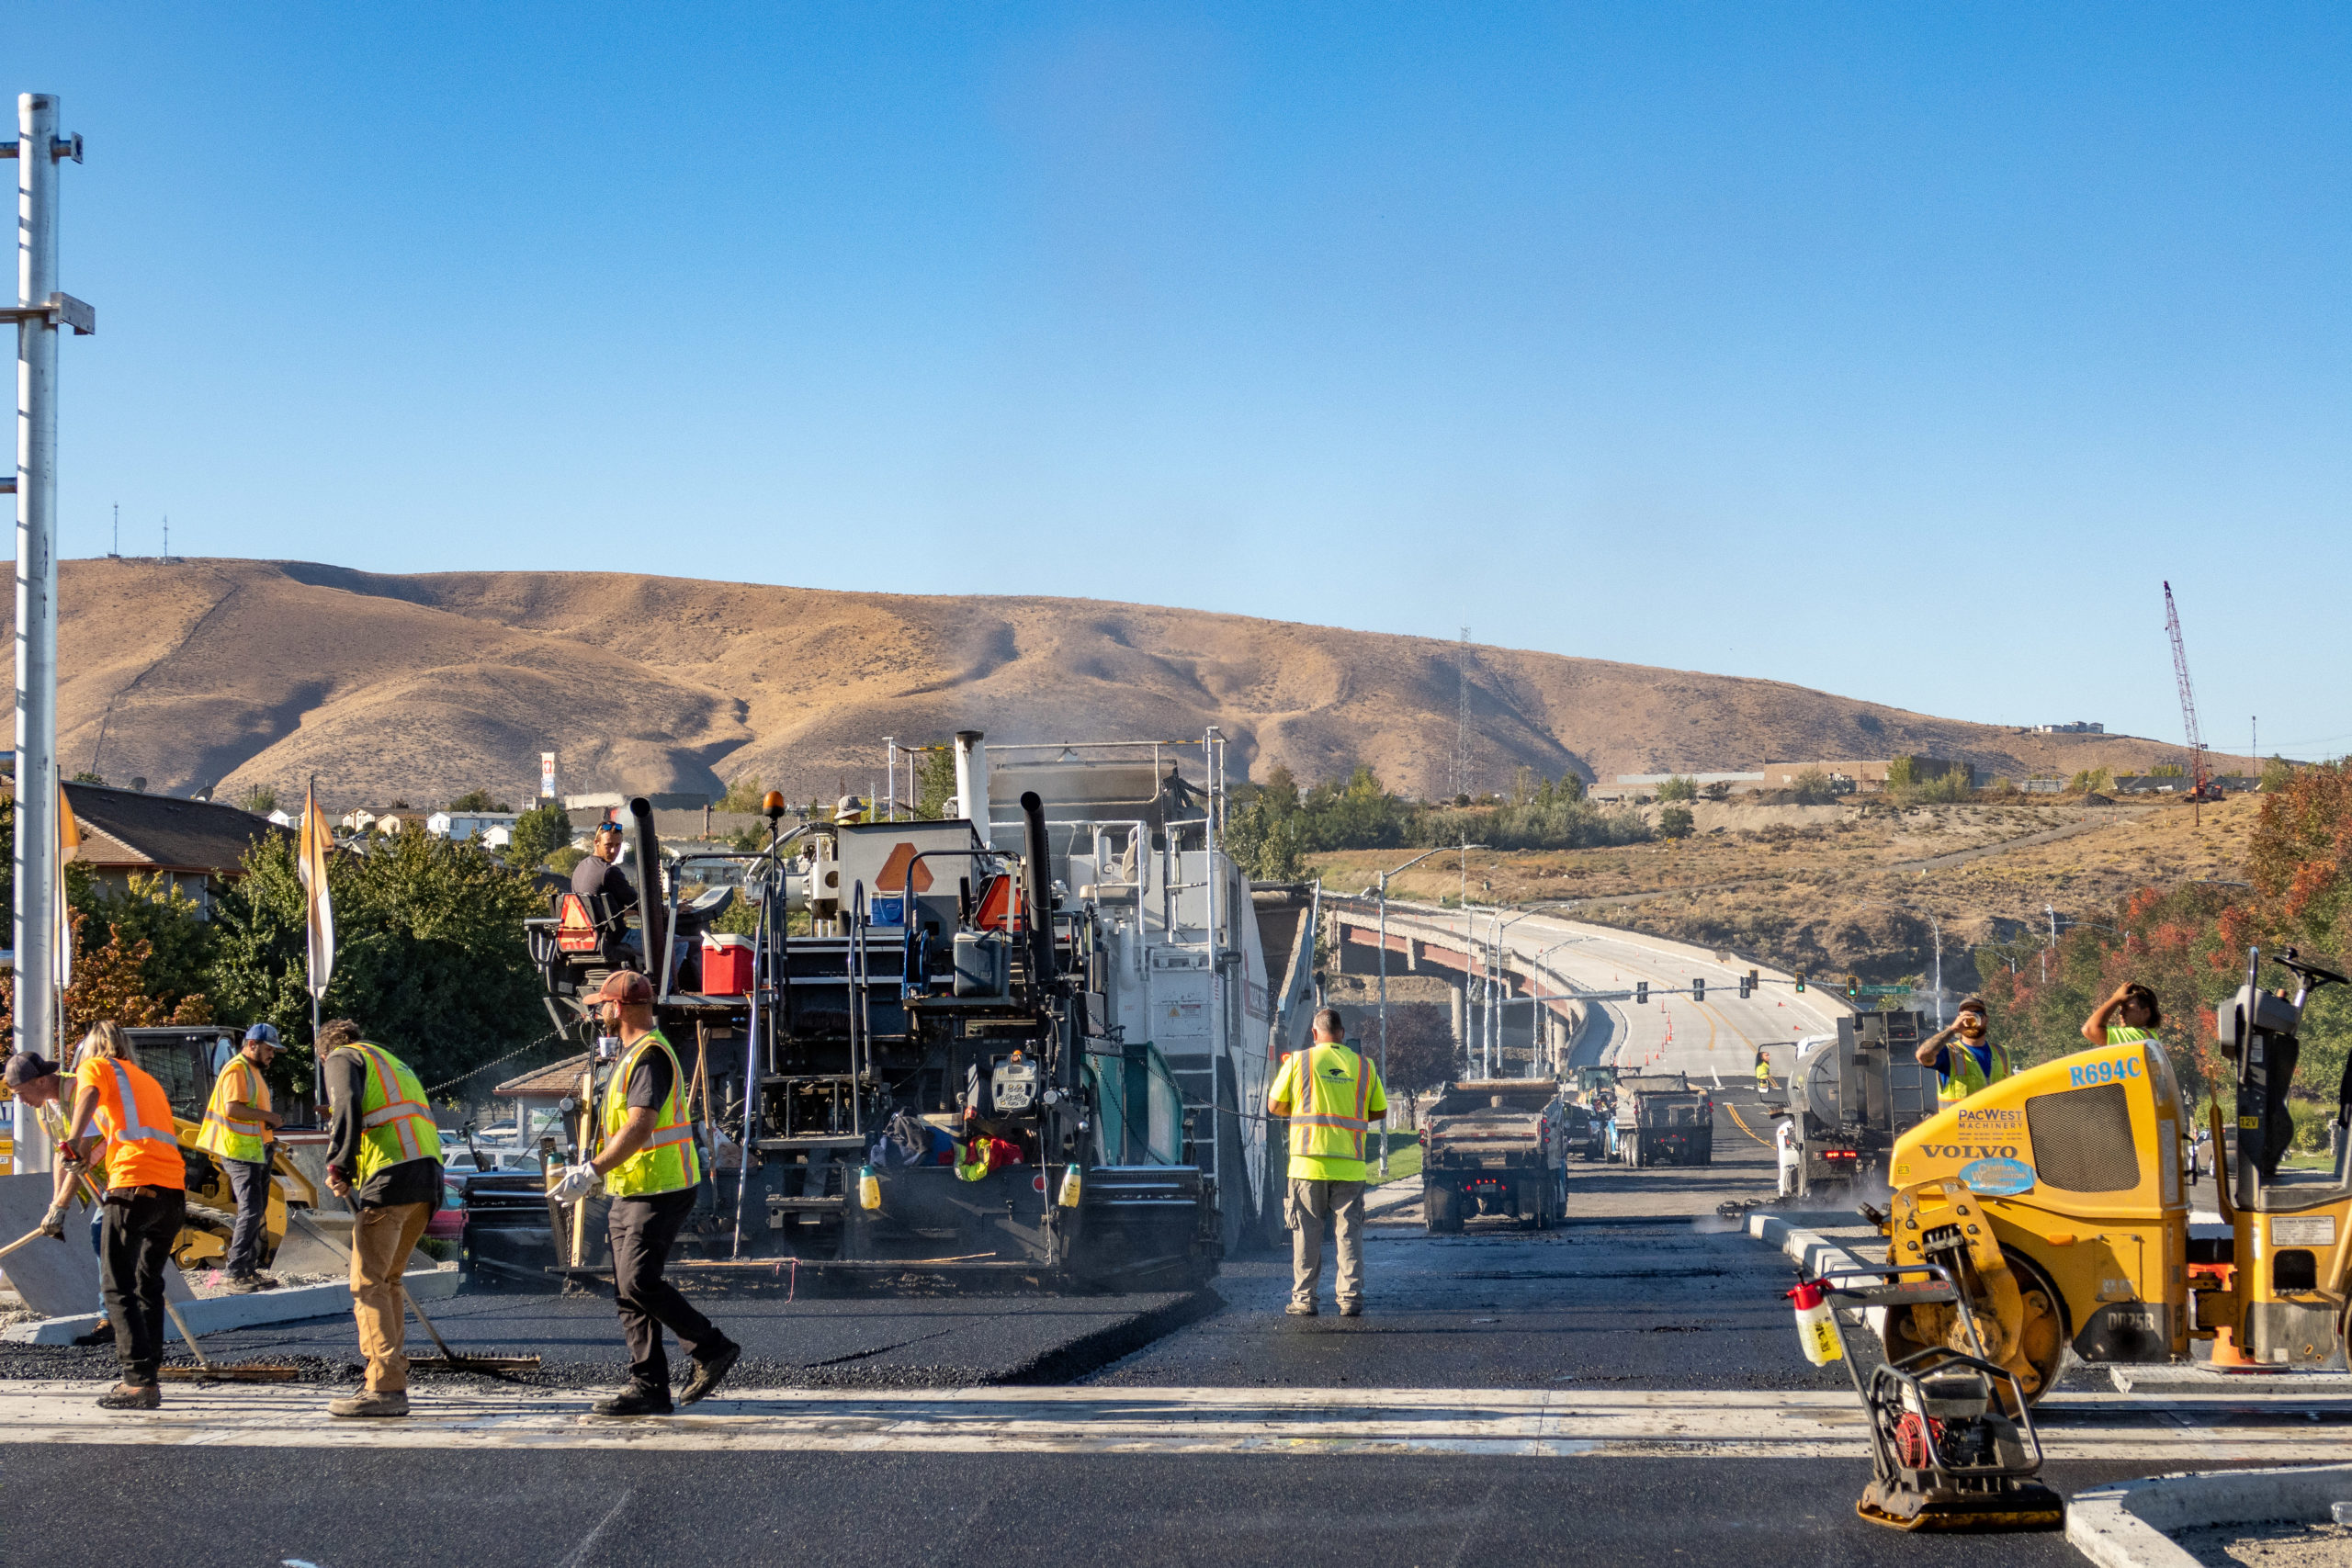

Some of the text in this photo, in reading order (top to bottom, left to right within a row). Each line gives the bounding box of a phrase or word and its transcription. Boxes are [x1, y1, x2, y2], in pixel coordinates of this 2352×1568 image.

[2069, 1056, 2142, 1087] R694C
[2240, 1118, 2257, 1127] 12V
[1919, 1145, 2018, 1158] VOLVO
